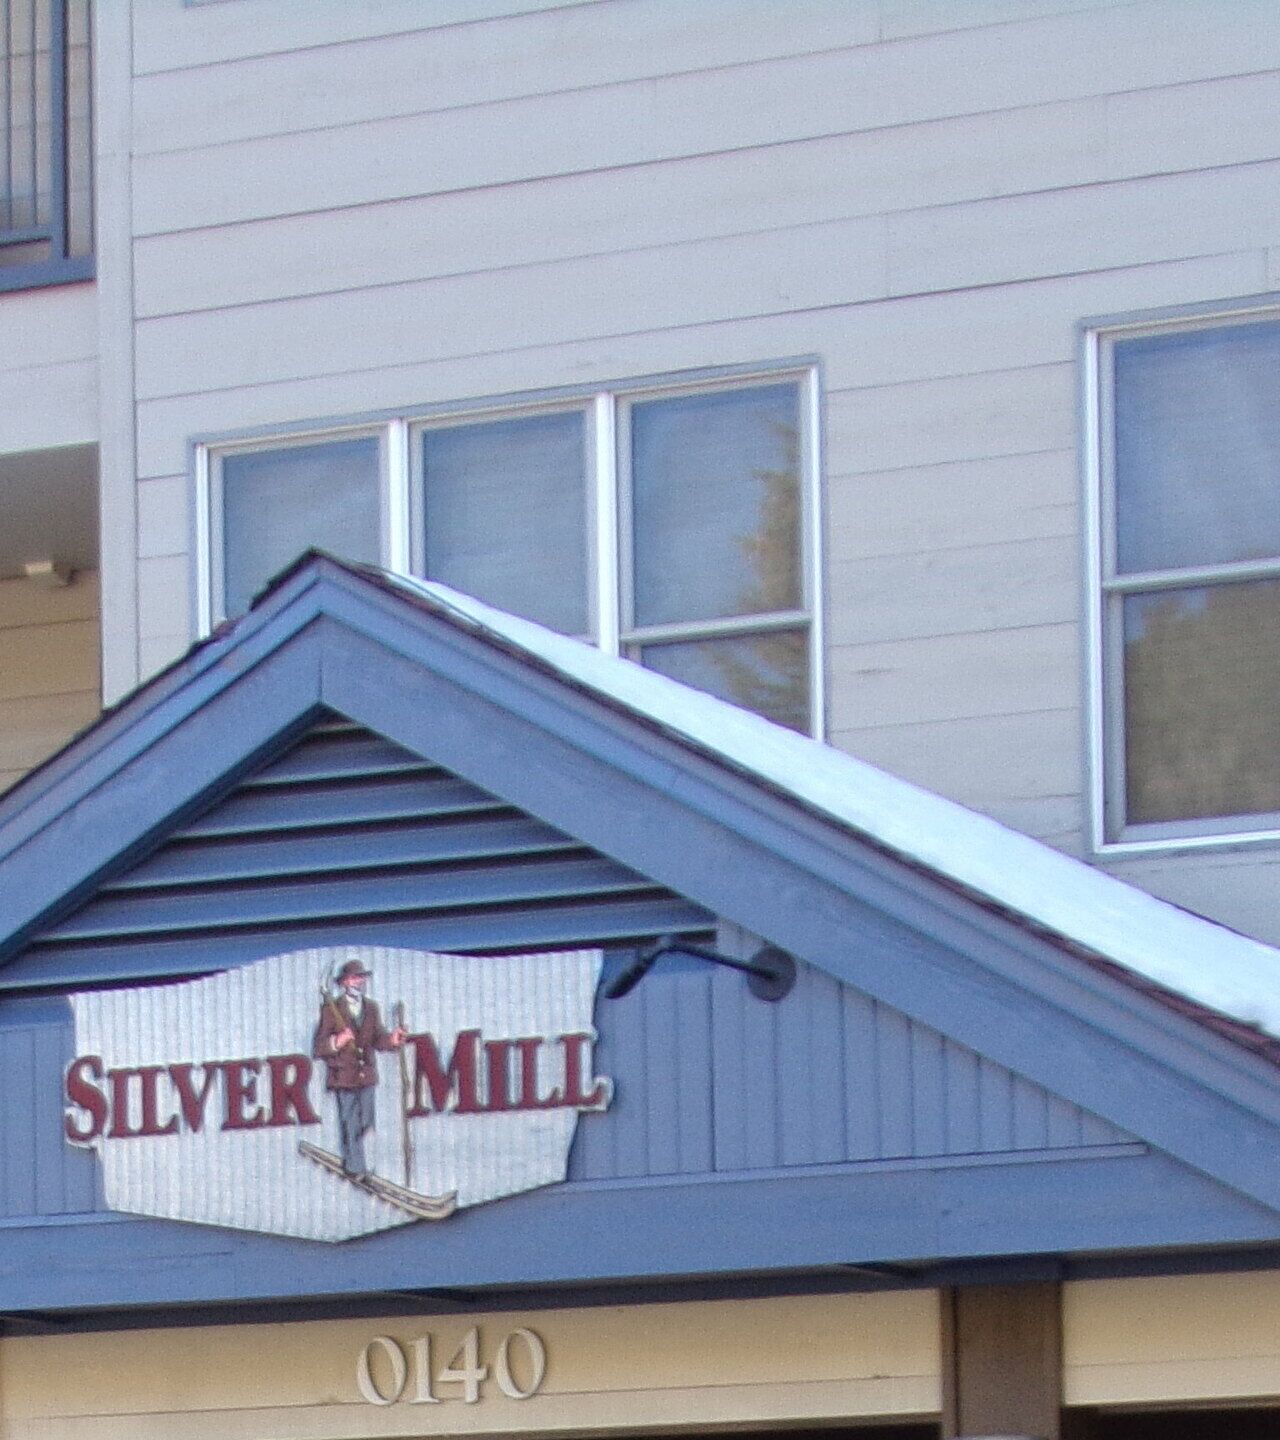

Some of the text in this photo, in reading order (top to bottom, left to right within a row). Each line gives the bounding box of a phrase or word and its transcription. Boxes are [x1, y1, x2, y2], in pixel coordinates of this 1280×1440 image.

[65, 1029, 607, 1143] SILVER MILL
[355, 1325, 547, 1407] 0140
